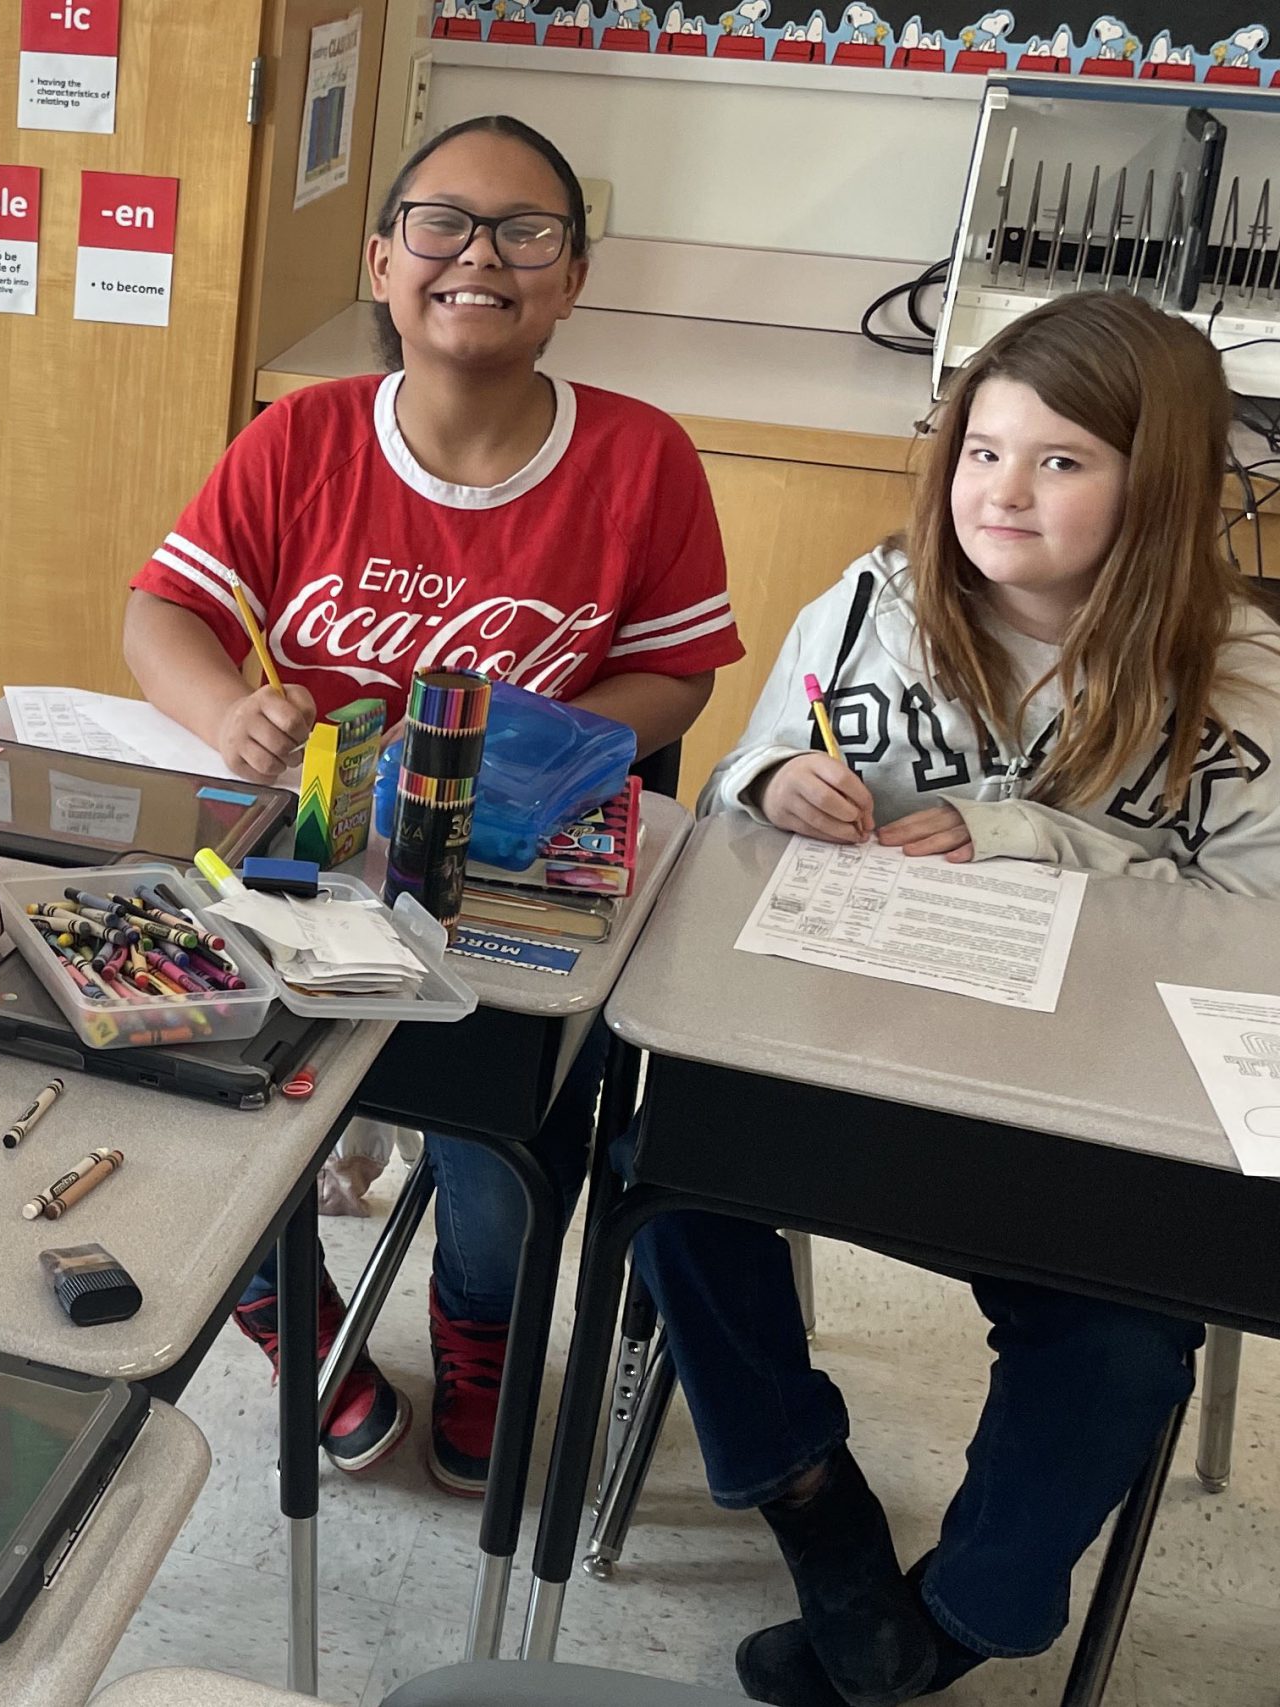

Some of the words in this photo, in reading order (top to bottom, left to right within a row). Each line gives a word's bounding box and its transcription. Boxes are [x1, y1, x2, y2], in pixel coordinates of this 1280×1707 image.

[50, 0, 91, 30] -ic
[37, 78, 66, 89] having
[68, 80, 81, 88] the
[37, 88, 99, 98] characteristics
[101, 90, 111, 99] of
[36, 97, 69, 108] relating
[71, 99, 80, 107] to
[101, 205, 154, 228] -en
[5, 252, 18, 261] be
[9, 264, 22, 274] of
[101, 281, 114, 291] to
[117, 282, 165, 296] become
[358, 557, 466, 609] Enjoy
[448, 814, 472, 840] 36
